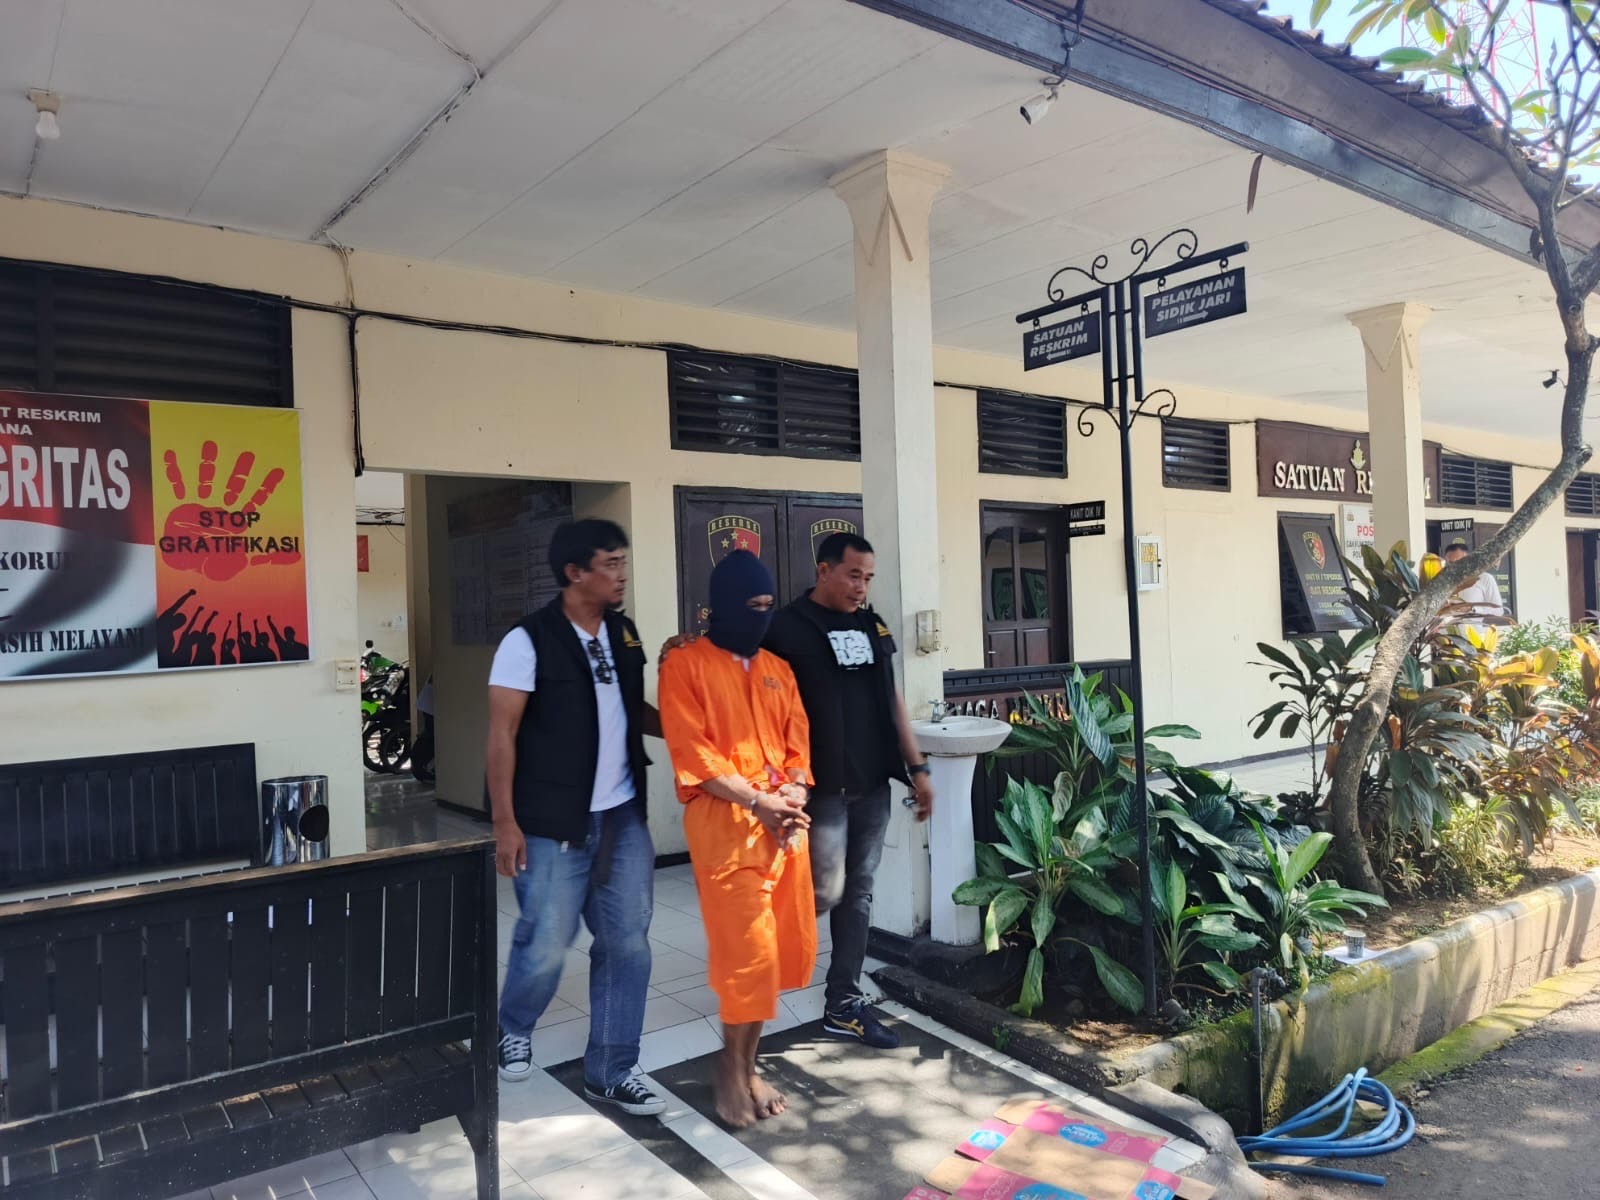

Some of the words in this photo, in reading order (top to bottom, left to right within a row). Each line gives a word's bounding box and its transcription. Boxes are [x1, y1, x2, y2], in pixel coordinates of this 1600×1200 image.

[1151, 275, 1236, 310] PELAYANAN
[1156, 301, 1195, 323] SIDIK
[1198, 291, 1232, 311] JARI
[1032, 320, 1085, 344] SATUAN
[1029, 333, 1089, 358] RESKRIM
[17, 407, 101, 423] RESKRIM
[1274, 461, 1345, 493] SATUAN
[199, 510, 261, 528] STOP
[158, 536, 300, 554] GRATIFIKASI
